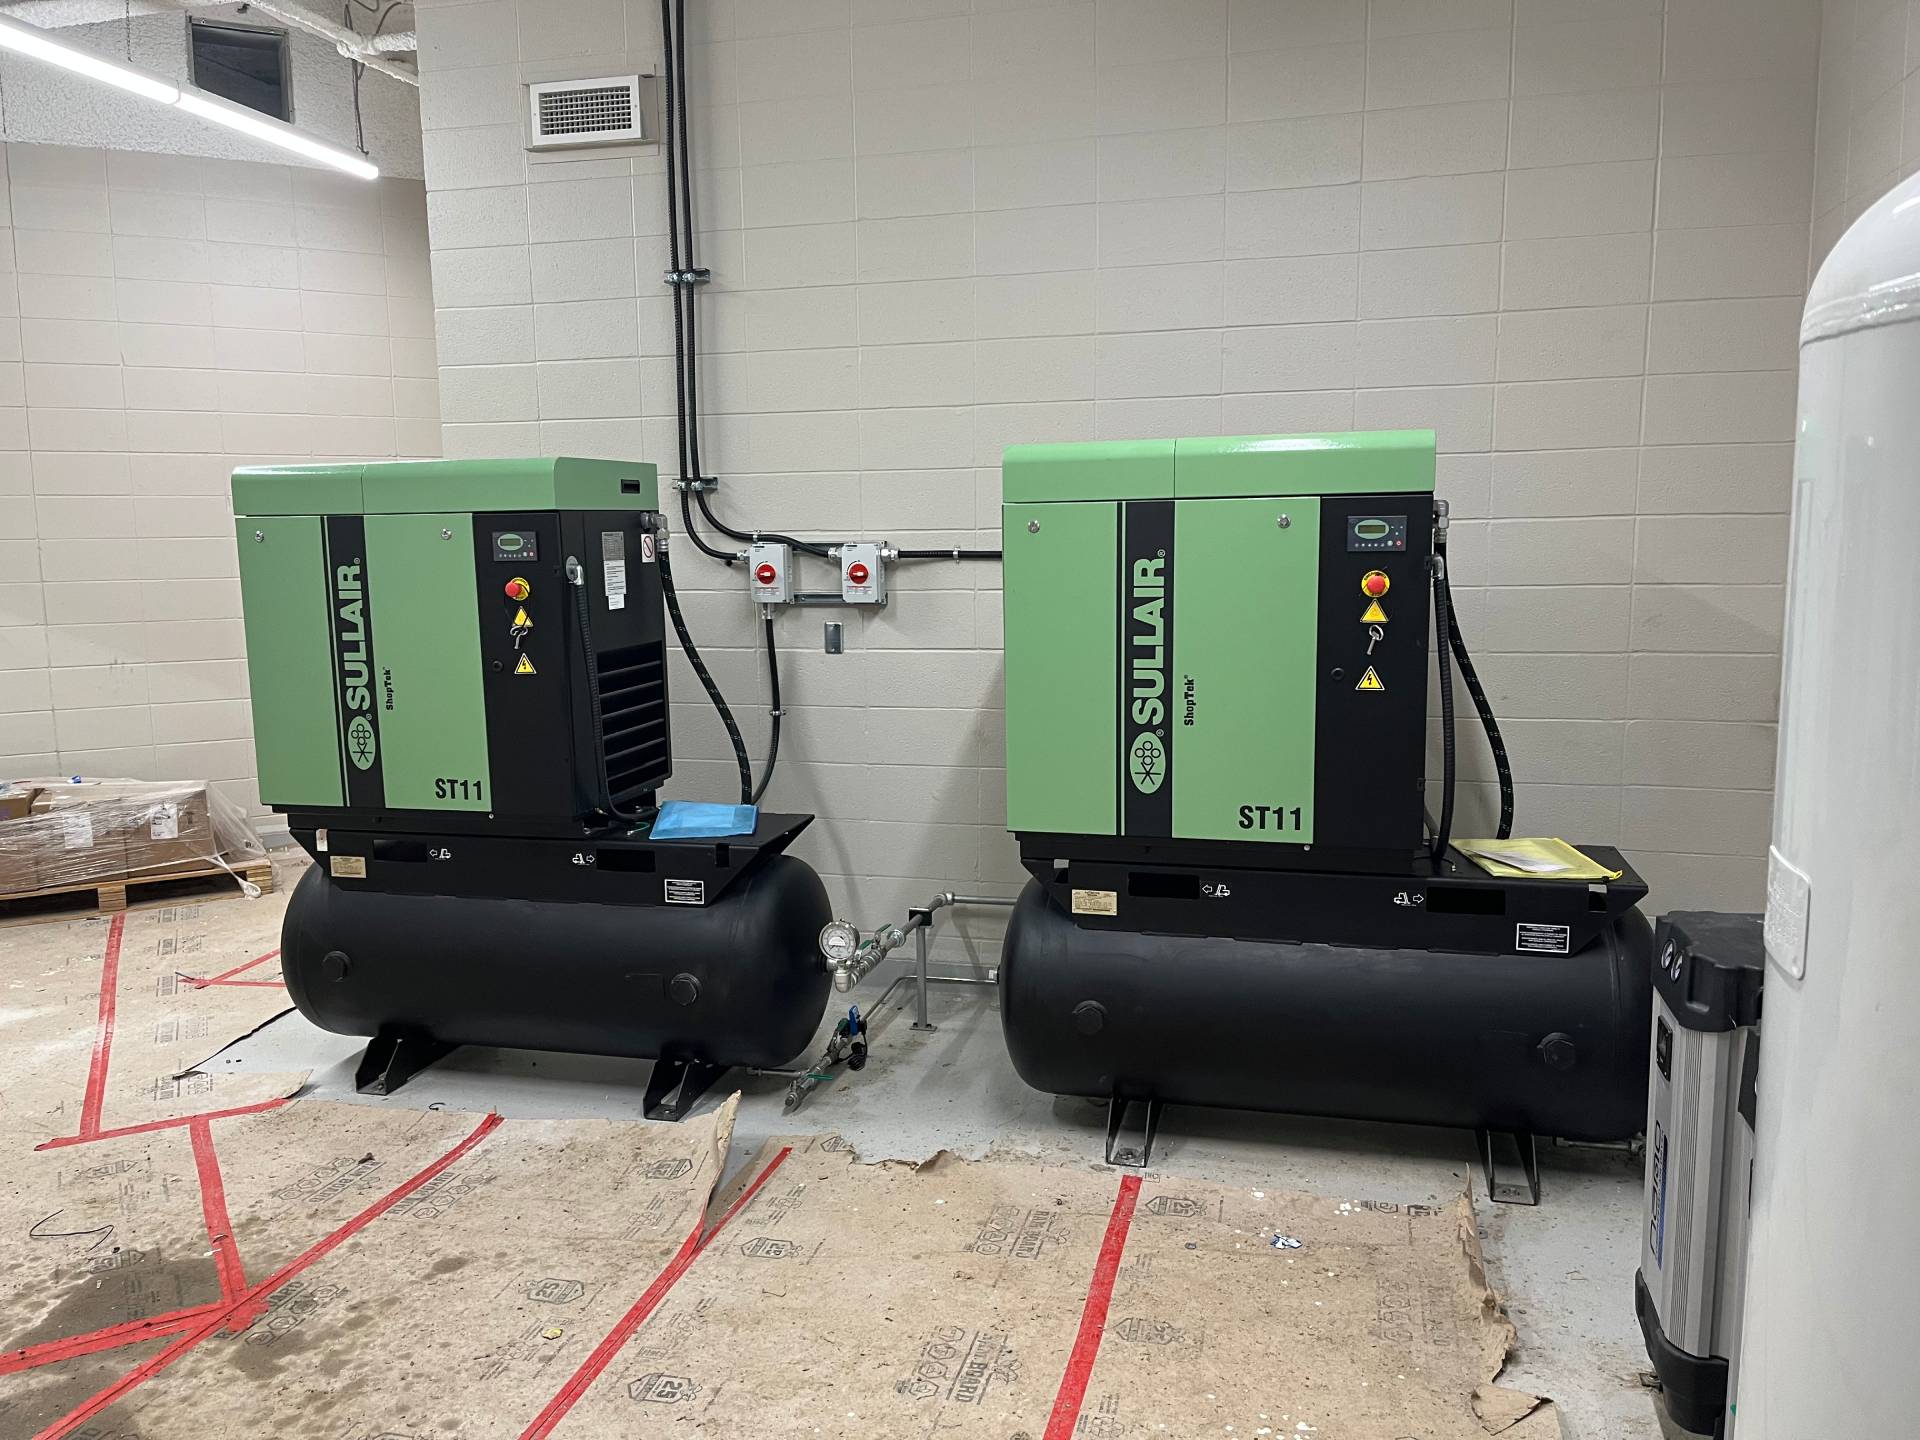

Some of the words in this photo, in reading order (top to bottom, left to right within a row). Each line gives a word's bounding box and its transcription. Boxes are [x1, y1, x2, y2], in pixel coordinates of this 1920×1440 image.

[434, 778, 482, 801] ST11
[1238, 805, 1302, 831] ST11
[656, 1380, 683, 1399] 25
